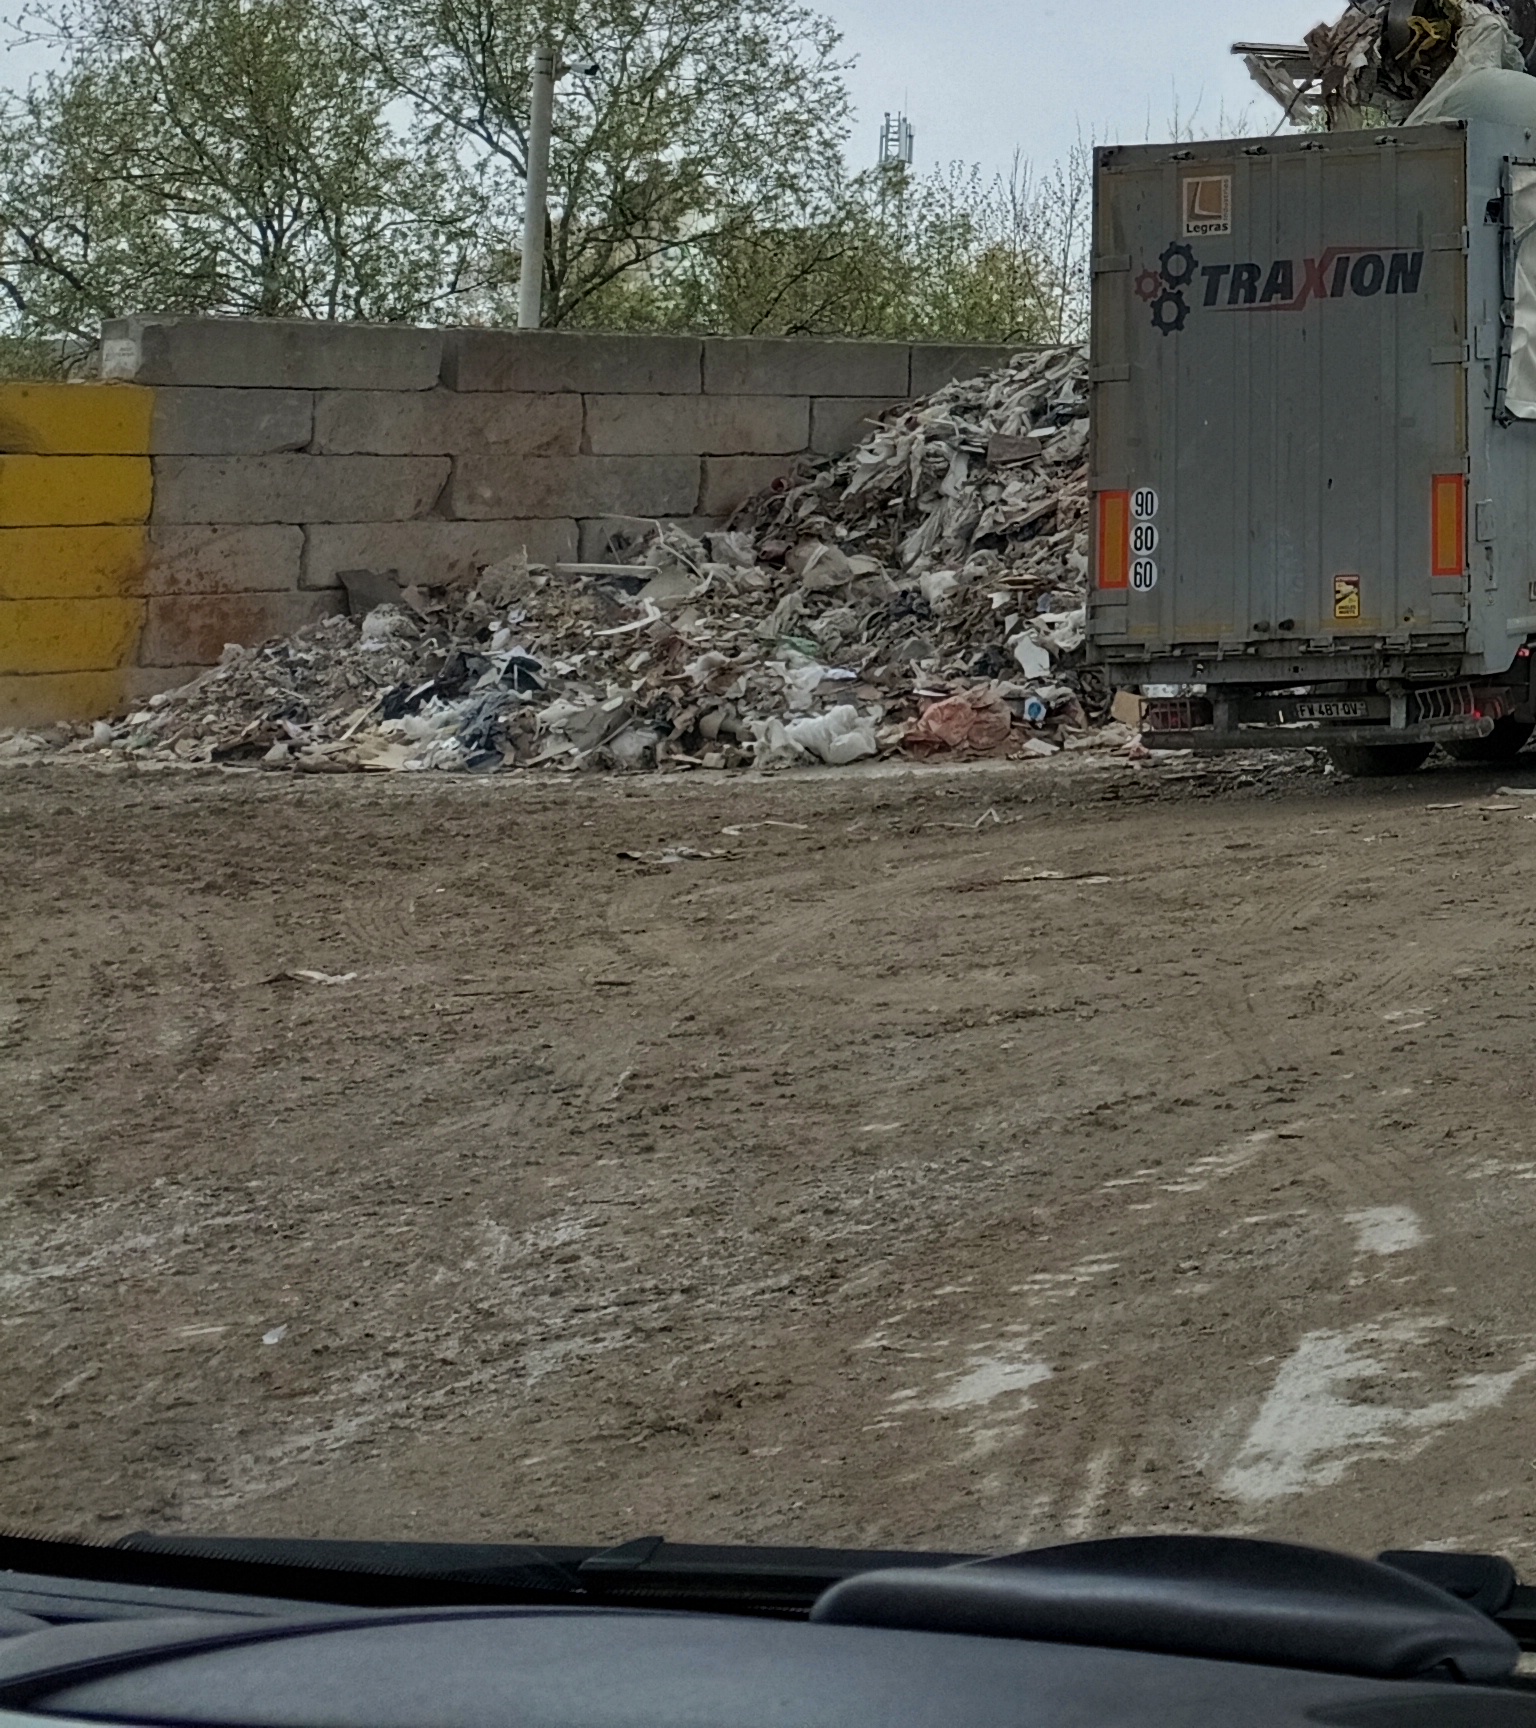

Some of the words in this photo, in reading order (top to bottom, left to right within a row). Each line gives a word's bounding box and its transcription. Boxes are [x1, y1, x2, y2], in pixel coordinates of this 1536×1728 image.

[1186, 223, 1229, 235] Legras
[1201, 248, 1425, 309] TRAXION
[1135, 491, 1154, 517] 90
[1134, 526, 1154, 551] 80
[1134, 561, 1153, 588] 60
